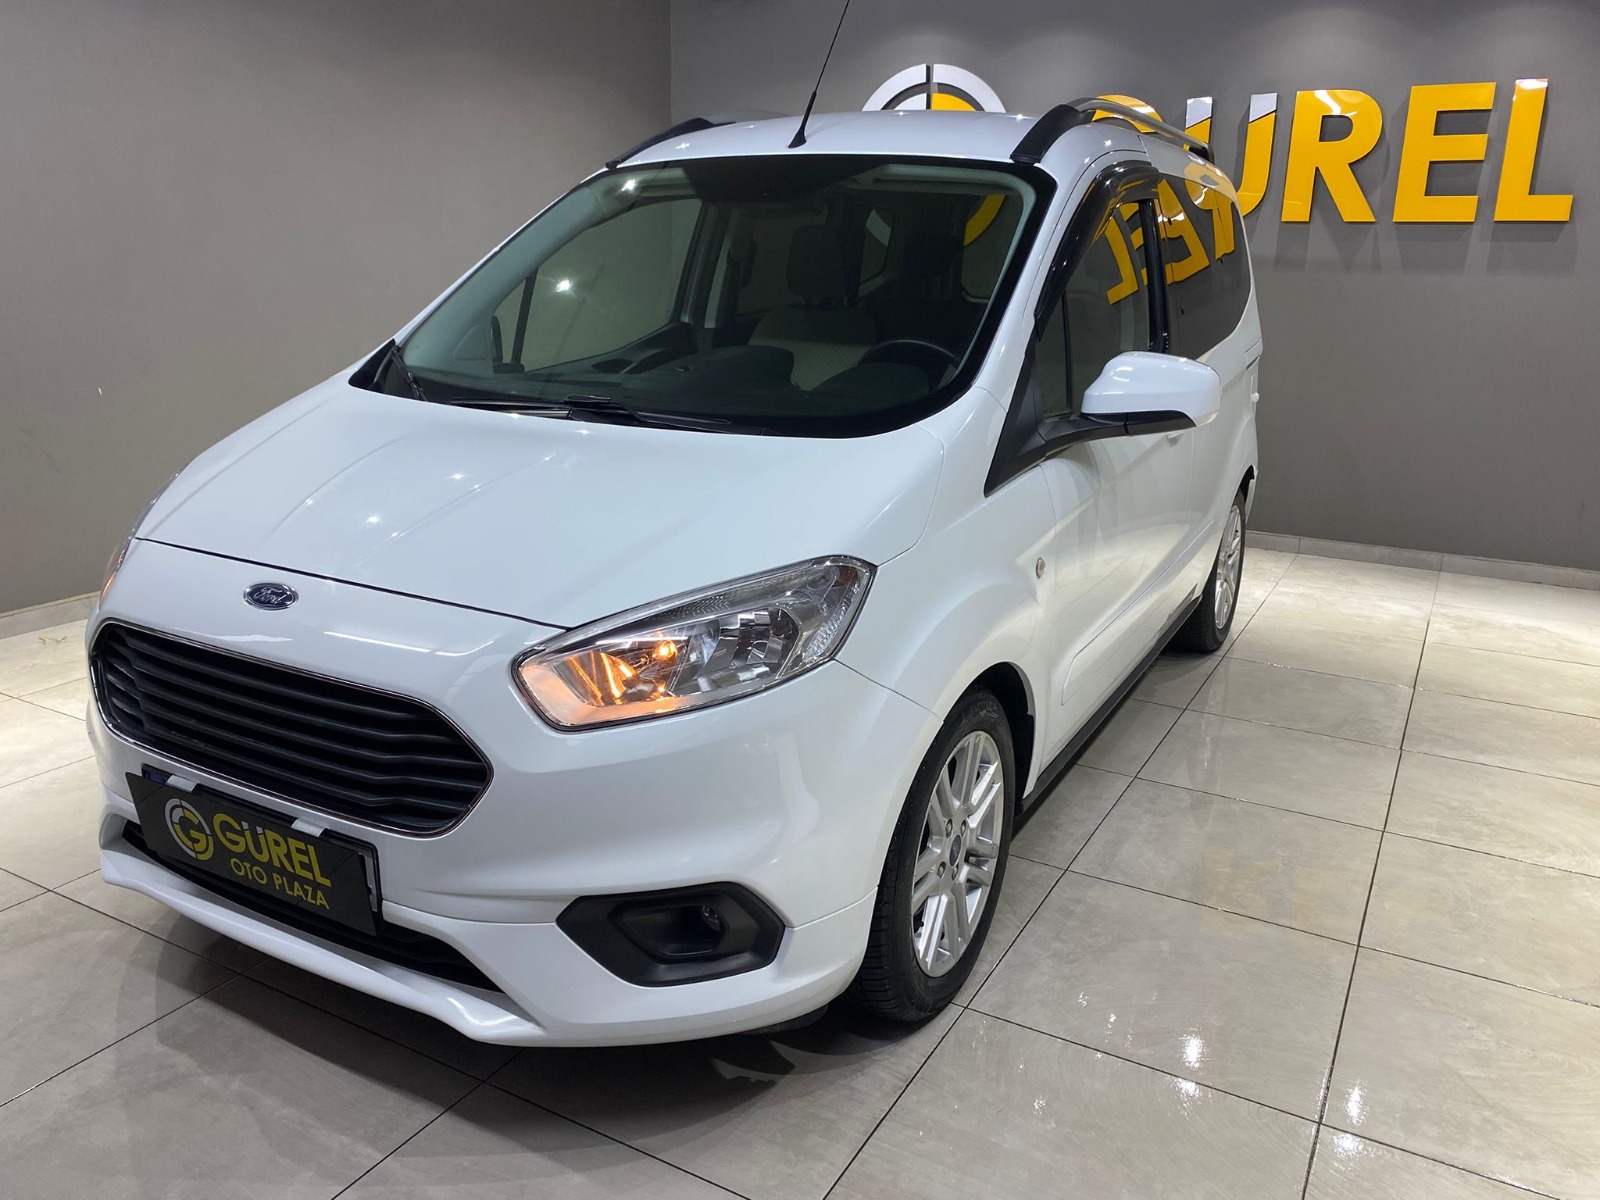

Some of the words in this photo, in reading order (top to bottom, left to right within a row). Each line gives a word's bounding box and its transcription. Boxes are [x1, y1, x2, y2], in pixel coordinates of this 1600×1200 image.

[253, 587, 287, 605] Ford
[230, 857, 268, 885] OTO
[272, 872, 330, 910] PLAZA
